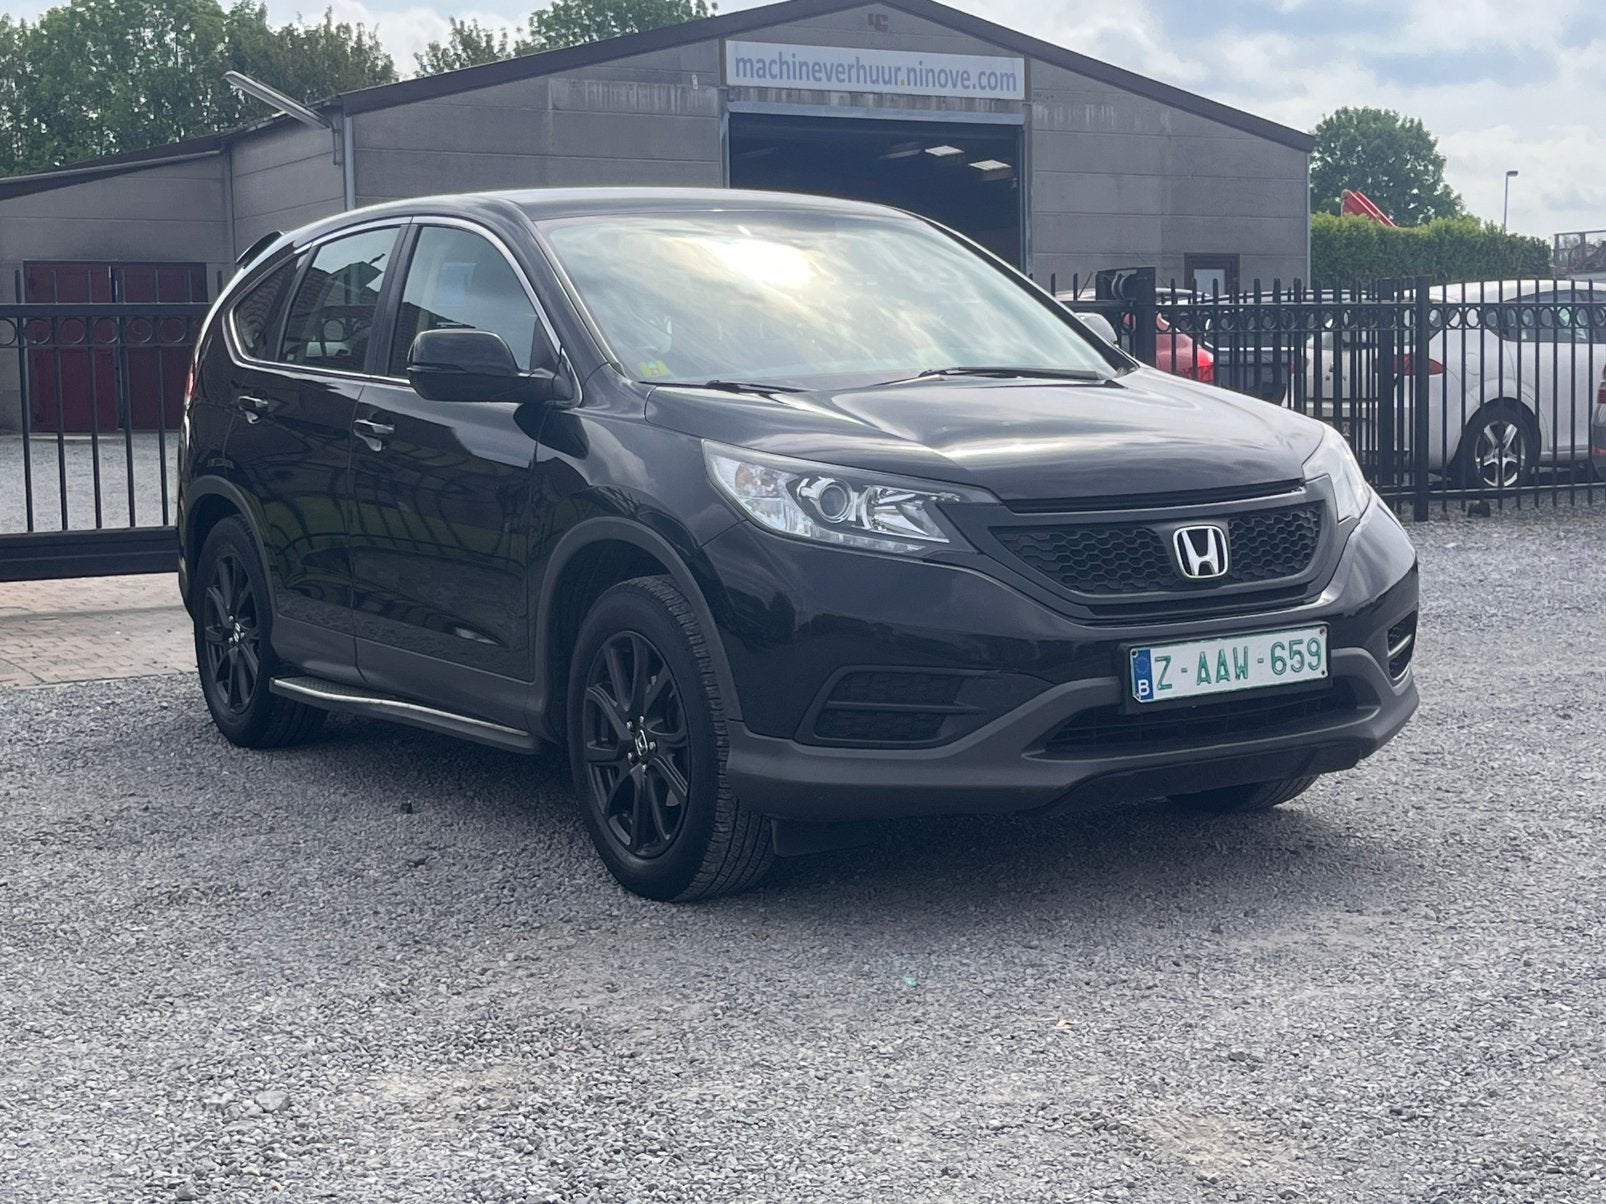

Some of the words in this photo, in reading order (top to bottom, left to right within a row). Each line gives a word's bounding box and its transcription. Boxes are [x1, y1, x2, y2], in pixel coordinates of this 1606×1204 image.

[735, 52, 1017, 92] machineverhuur.ninove.com
[1154, 637, 1322, 691] Z-AAW-659
[1137, 679, 1150, 696] B
